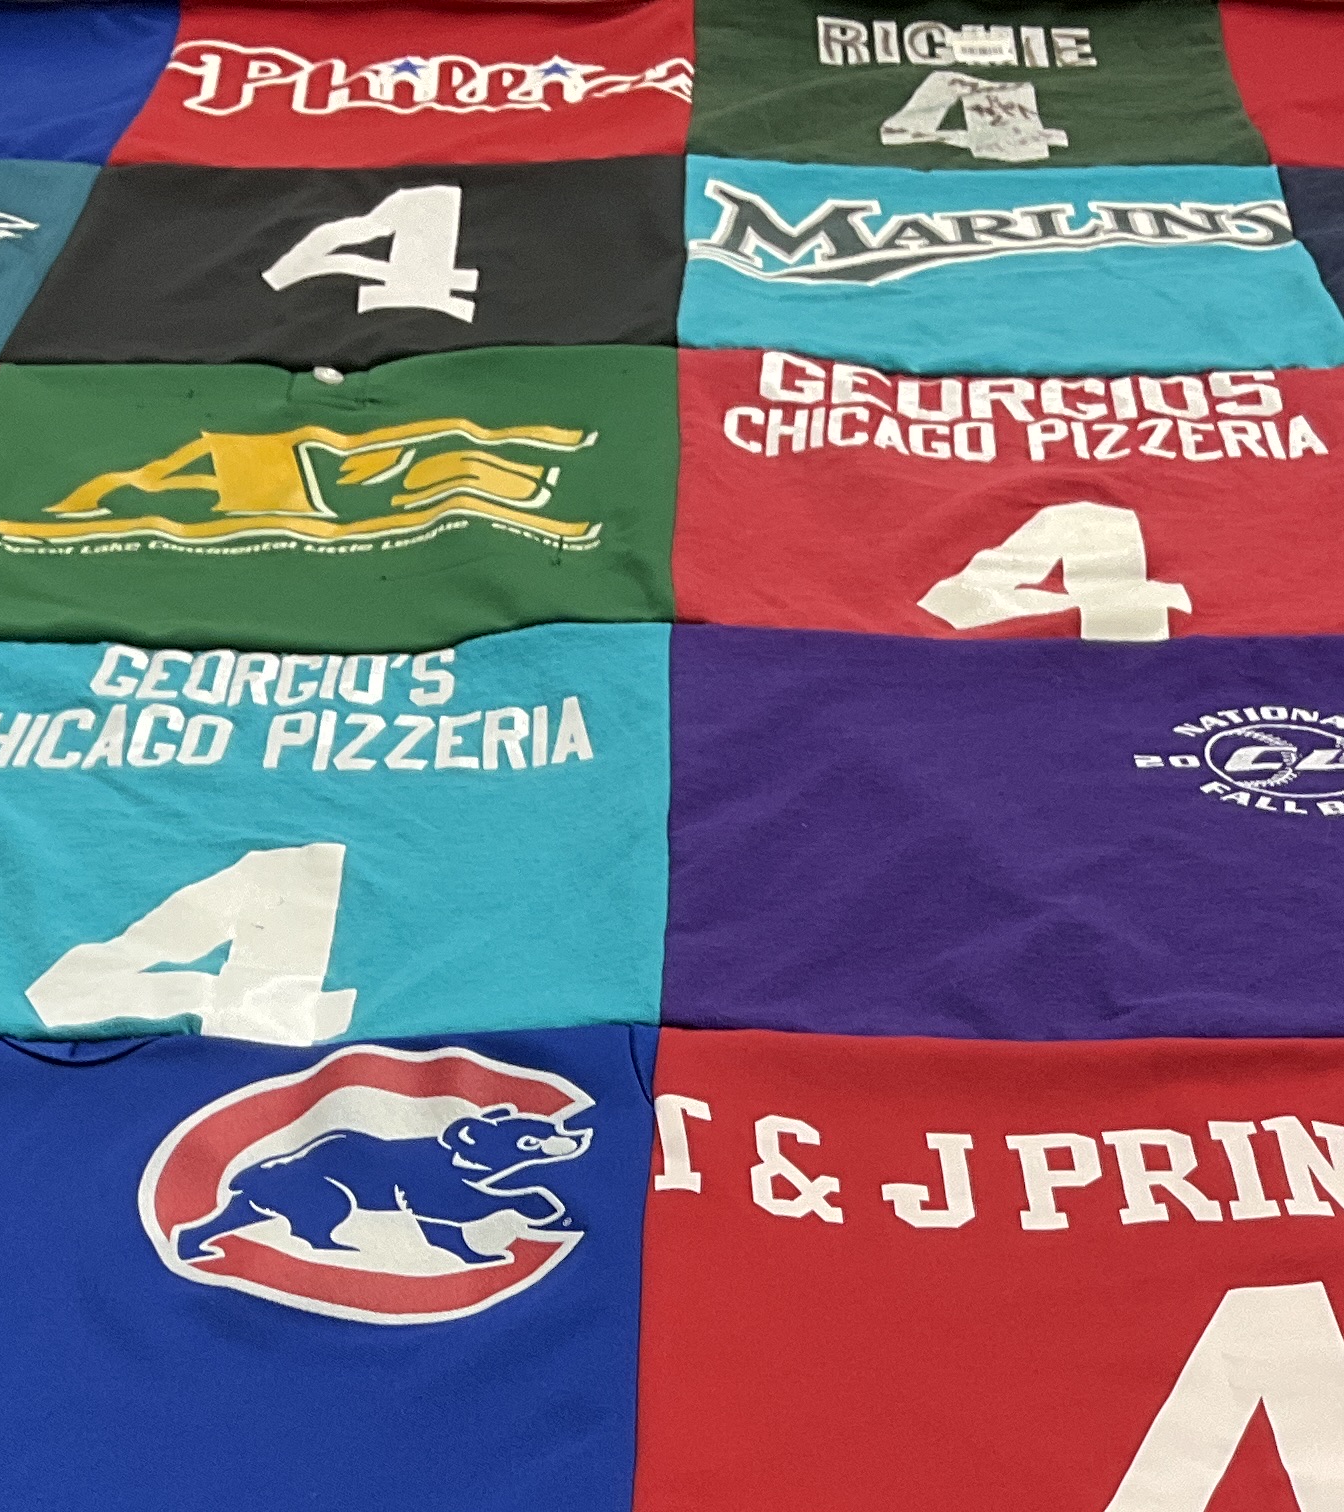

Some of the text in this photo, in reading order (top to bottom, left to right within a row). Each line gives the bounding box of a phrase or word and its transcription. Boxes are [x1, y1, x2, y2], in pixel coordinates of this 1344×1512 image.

[164, 38, 693, 116] Philli
[880, 70, 1068, 163] 4
[262, 185, 479, 323] 4
[696, 179, 1296, 270] MARLINS
[724, 405, 1329, 463] CHICAGO PIZZERIA
[916, 500, 1192, 642] 4
[89, 644, 455, 706] GEORGIO'S
[263, 697, 594, 771] PIZZERIA
[1200, 781, 1308, 814] FALL
[25, 843, 356, 1045] 4
[750, 1114, 844, 1225] &
[881, 1133, 974, 1229] J
